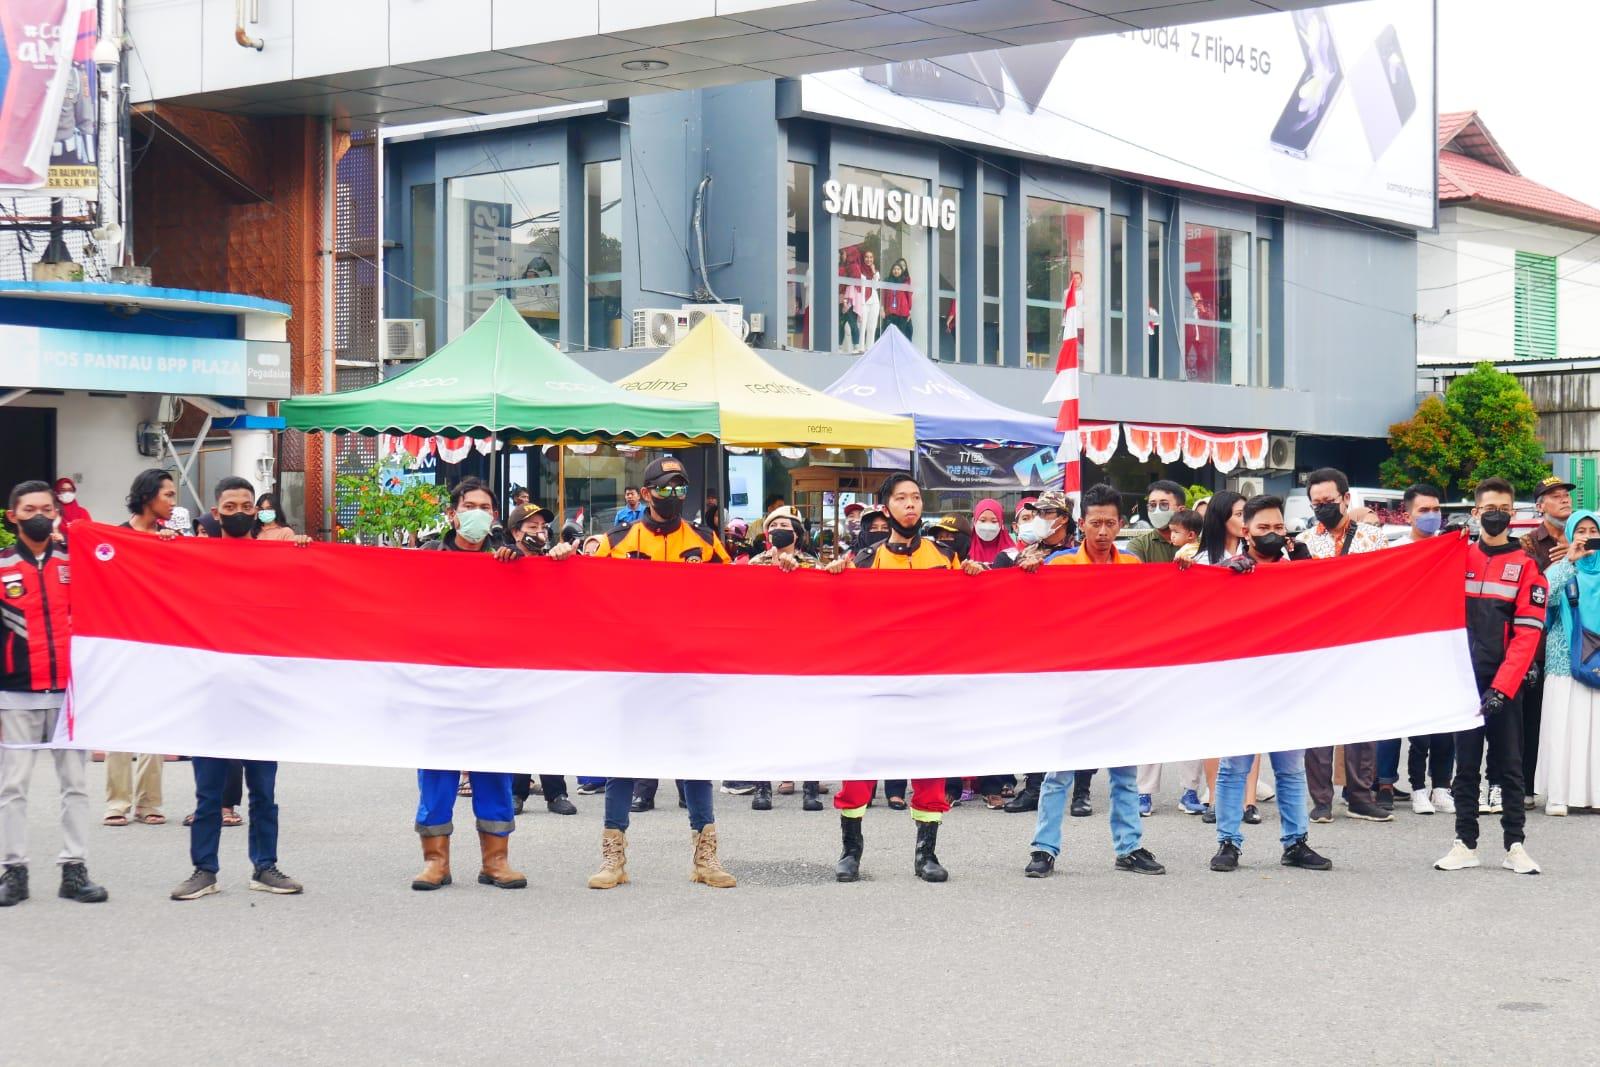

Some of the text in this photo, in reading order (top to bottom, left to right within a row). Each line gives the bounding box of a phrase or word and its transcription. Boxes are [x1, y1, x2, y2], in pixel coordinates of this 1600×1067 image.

[1191, 32, 1271, 75] Z Flip4 5G
[823, 179, 956, 231] SAMSUNG
[43, 351, 242, 376] POS PANTAU BPP PLAZA
[247, 367, 291, 380] Pegadaian
[620, 378, 688, 392] realme
[745, 382, 812, 397] realme
[807, 424, 833, 434] realme
